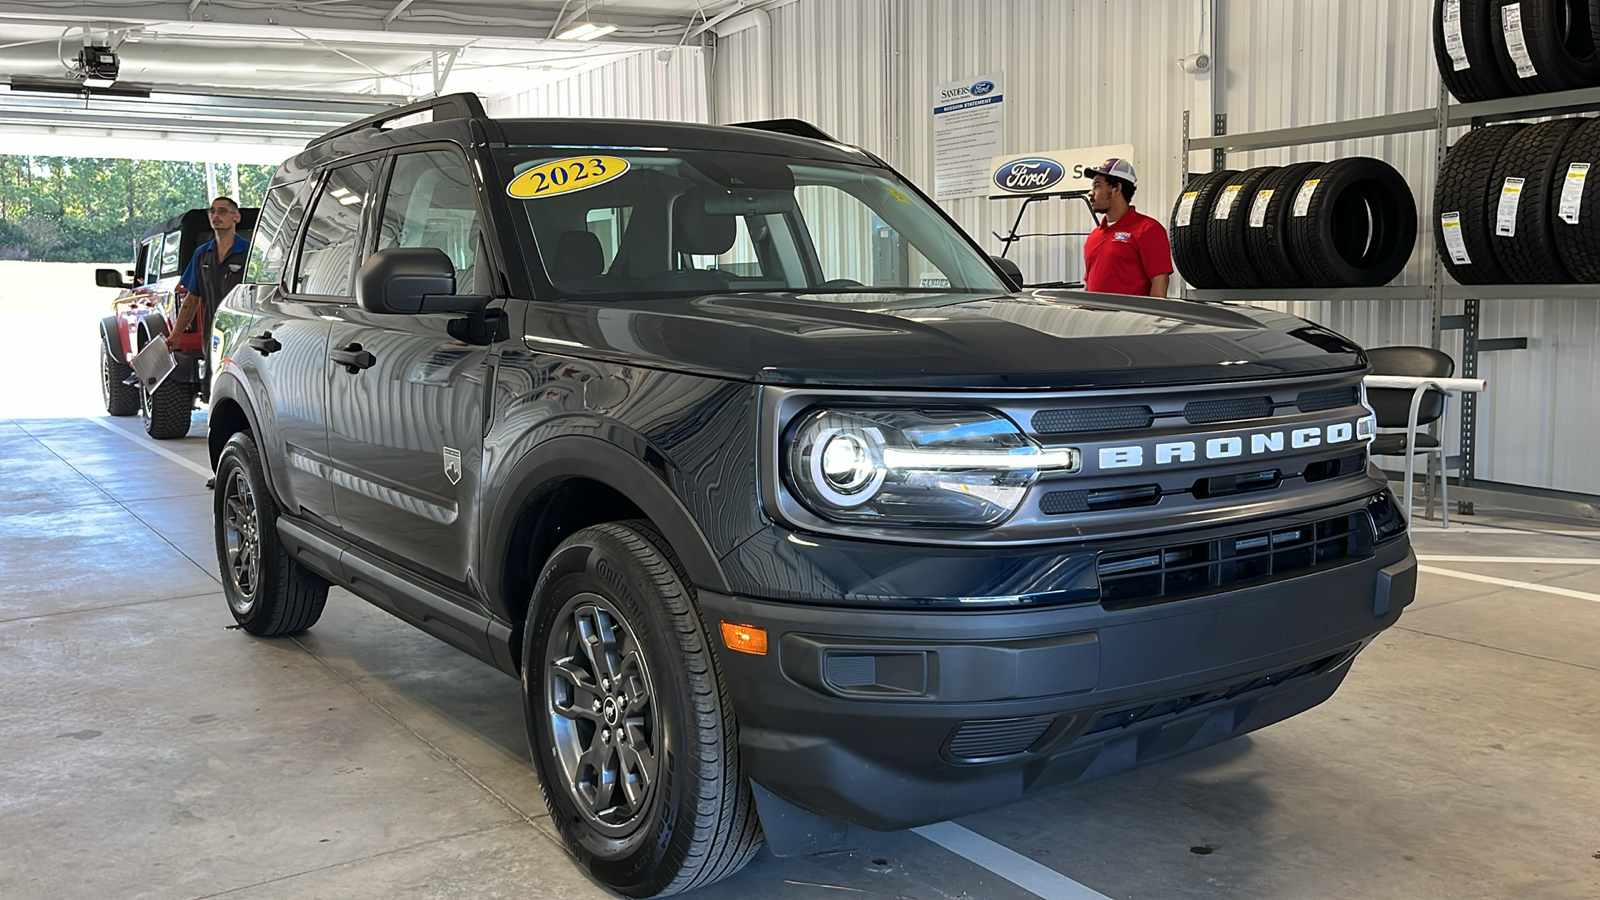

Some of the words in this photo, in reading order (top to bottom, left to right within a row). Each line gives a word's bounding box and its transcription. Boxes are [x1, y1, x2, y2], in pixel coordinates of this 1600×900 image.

[941, 86, 970, 99] SANDERS
[974, 82, 990, 94] Ford
[943, 104, 963, 112] MISSION
[963, 98, 992, 108] STATEMENT
[530, 158, 607, 194] 2023
[1006, 162, 1051, 187] Ford
[1099, 422, 1352, 469] BRONCO
